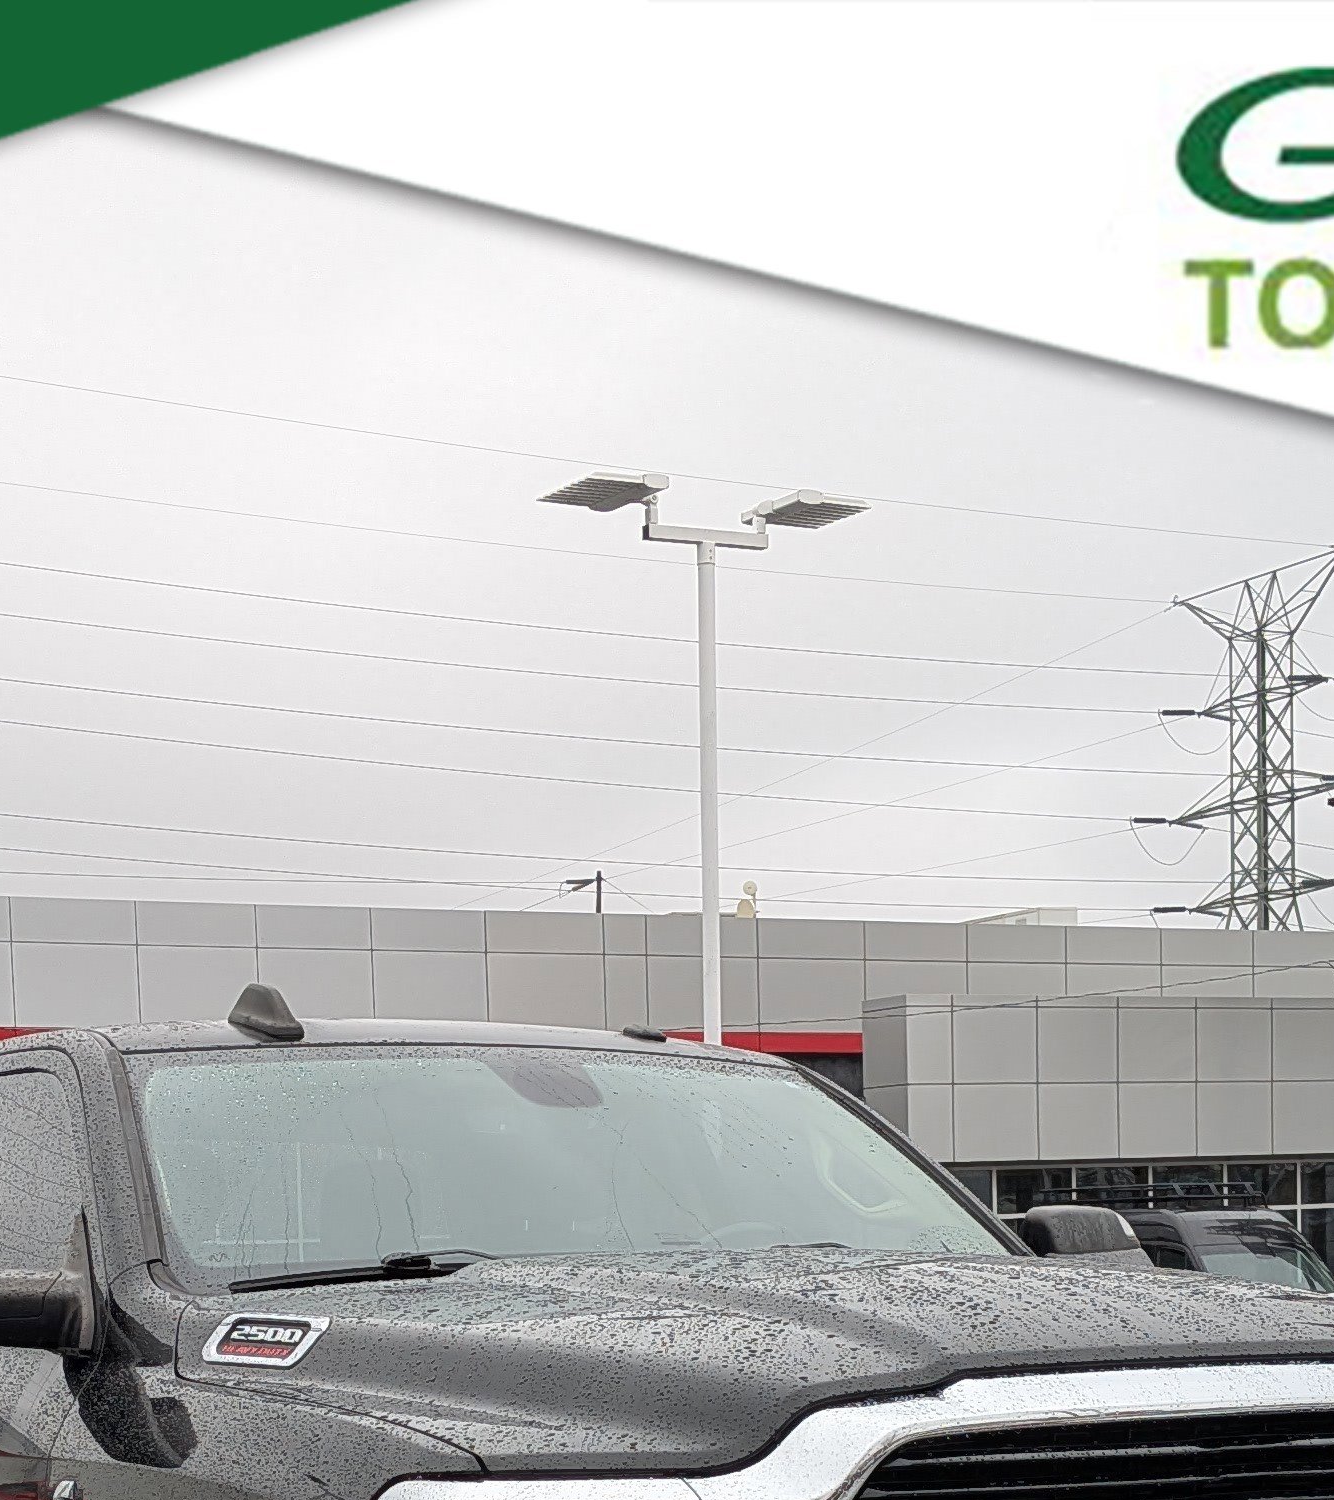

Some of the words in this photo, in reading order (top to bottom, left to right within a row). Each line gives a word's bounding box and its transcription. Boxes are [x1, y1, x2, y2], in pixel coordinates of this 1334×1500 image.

[230, 1325, 304, 1343] 2500
[221, 1344, 257, 1354] HEAVY
[258, 1347, 291, 1356] DUTY
